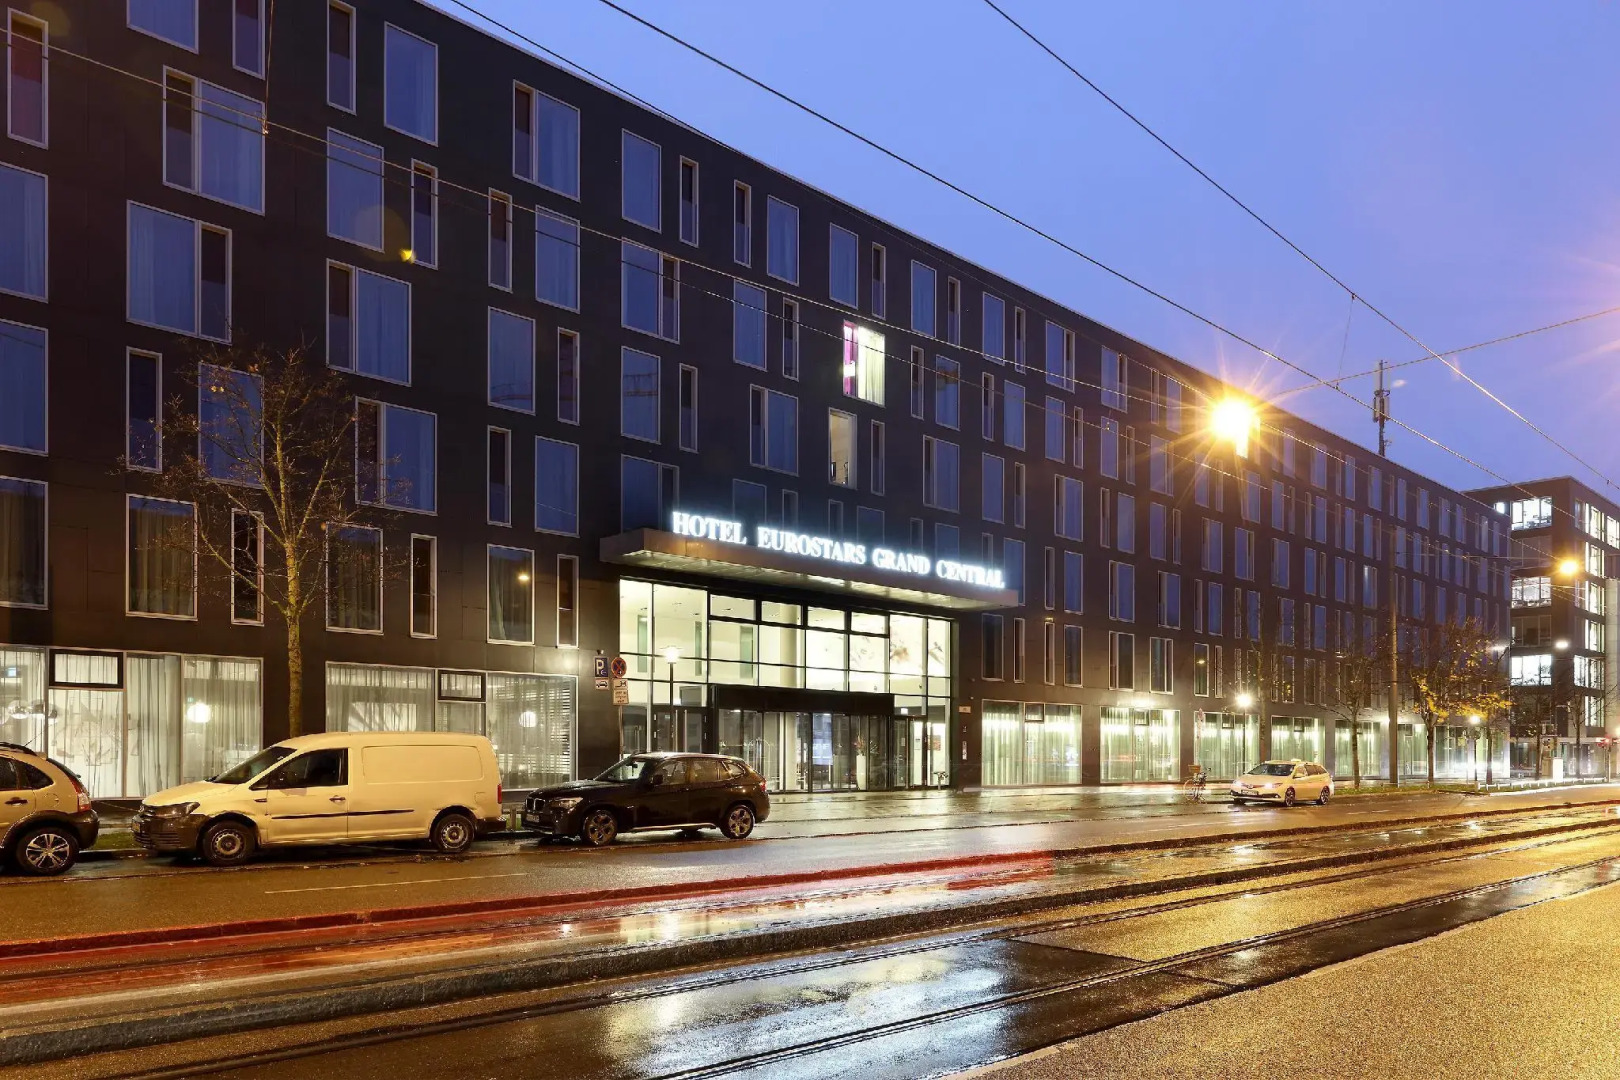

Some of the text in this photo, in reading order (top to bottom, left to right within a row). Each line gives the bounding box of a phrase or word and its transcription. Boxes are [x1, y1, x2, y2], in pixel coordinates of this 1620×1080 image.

[672, 511, 1006, 588] HOTEL EUROSTARS GRAND CENTRAL
[596, 659, 604, 674] P
